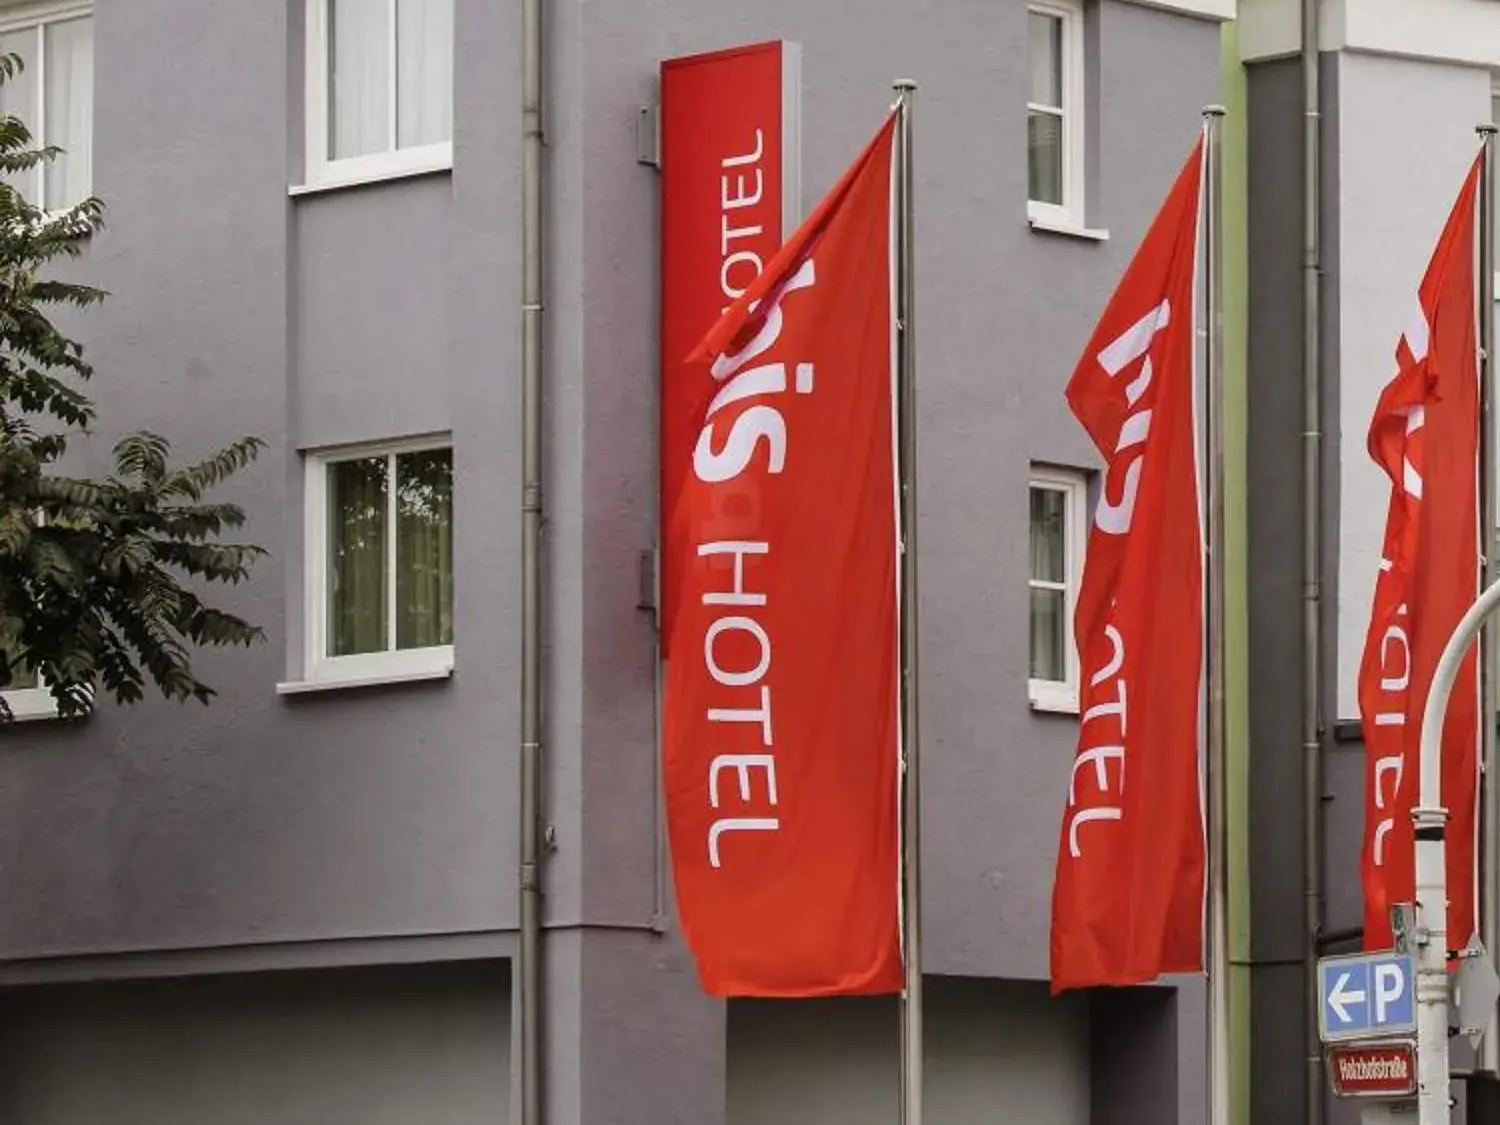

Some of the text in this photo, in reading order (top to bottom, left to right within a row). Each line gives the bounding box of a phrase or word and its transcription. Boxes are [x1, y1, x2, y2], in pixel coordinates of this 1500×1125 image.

[720, 127, 764, 313] OTEL
[696, 540, 780, 869] HOTEL
[1374, 963, 1405, 1023] P
